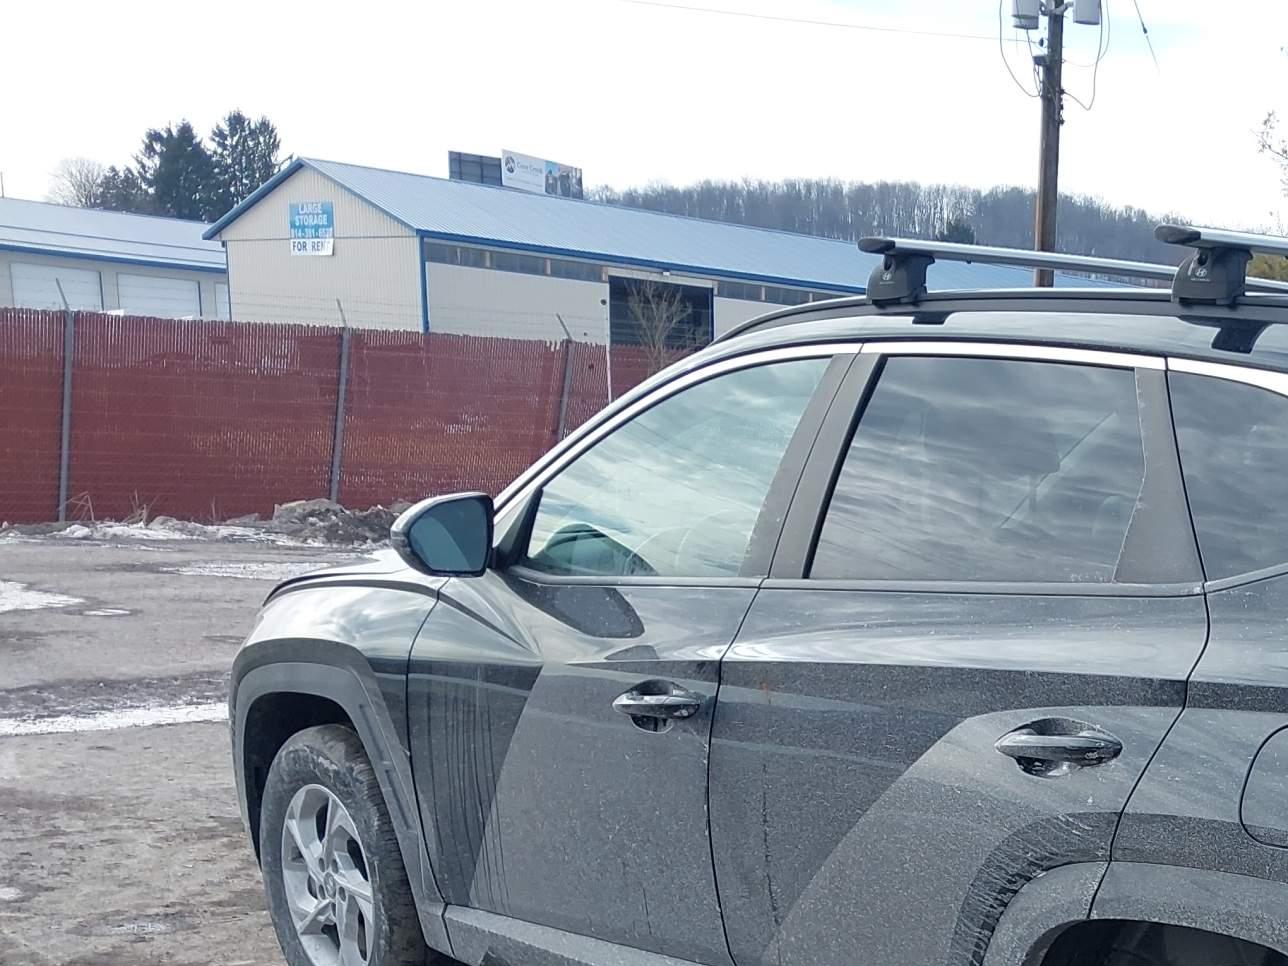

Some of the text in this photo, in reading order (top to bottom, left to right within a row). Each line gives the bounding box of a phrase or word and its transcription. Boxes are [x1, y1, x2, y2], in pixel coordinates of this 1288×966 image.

[298, 203, 323, 214] LARGE
[294, 214, 328, 226] STORAGE
[292, 241, 308, 252] FOR
